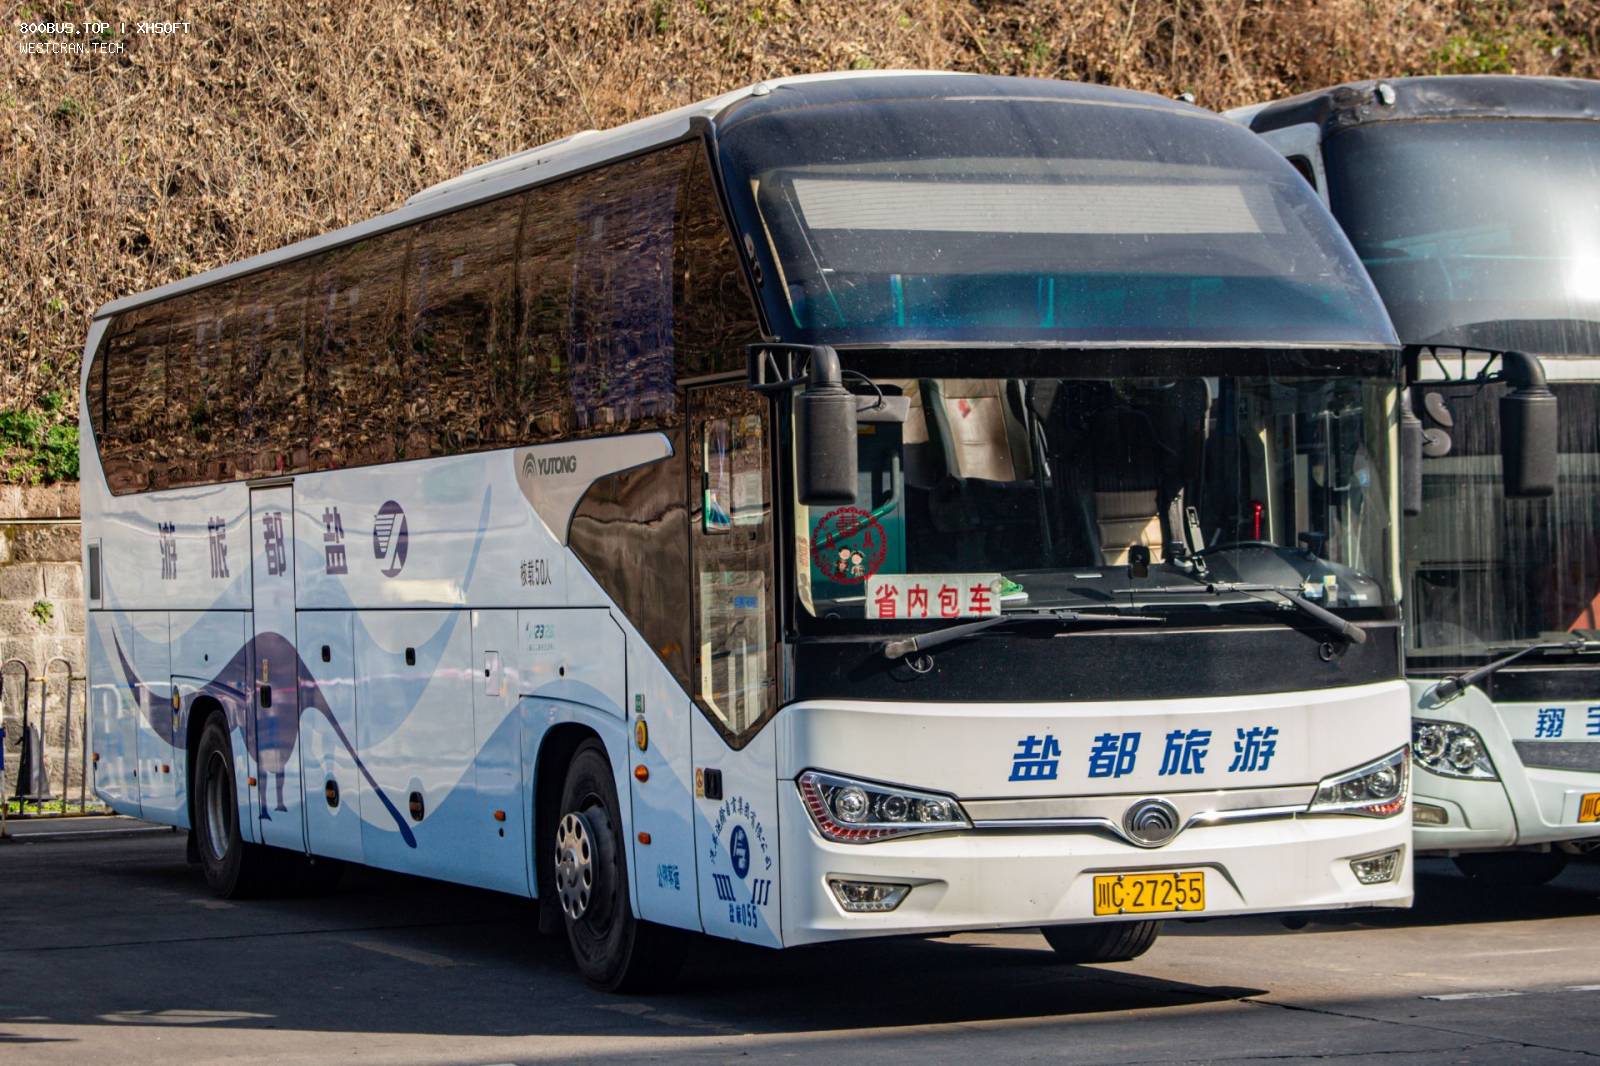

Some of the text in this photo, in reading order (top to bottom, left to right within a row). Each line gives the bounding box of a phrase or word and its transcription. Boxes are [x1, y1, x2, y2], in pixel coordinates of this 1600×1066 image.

[537, 454, 578, 476] YUTONG
[520, 559, 552, 587] 核载50人
[874, 583, 992, 619] 省内包车
[1007, 726, 1279, 782] 盐都旅游
